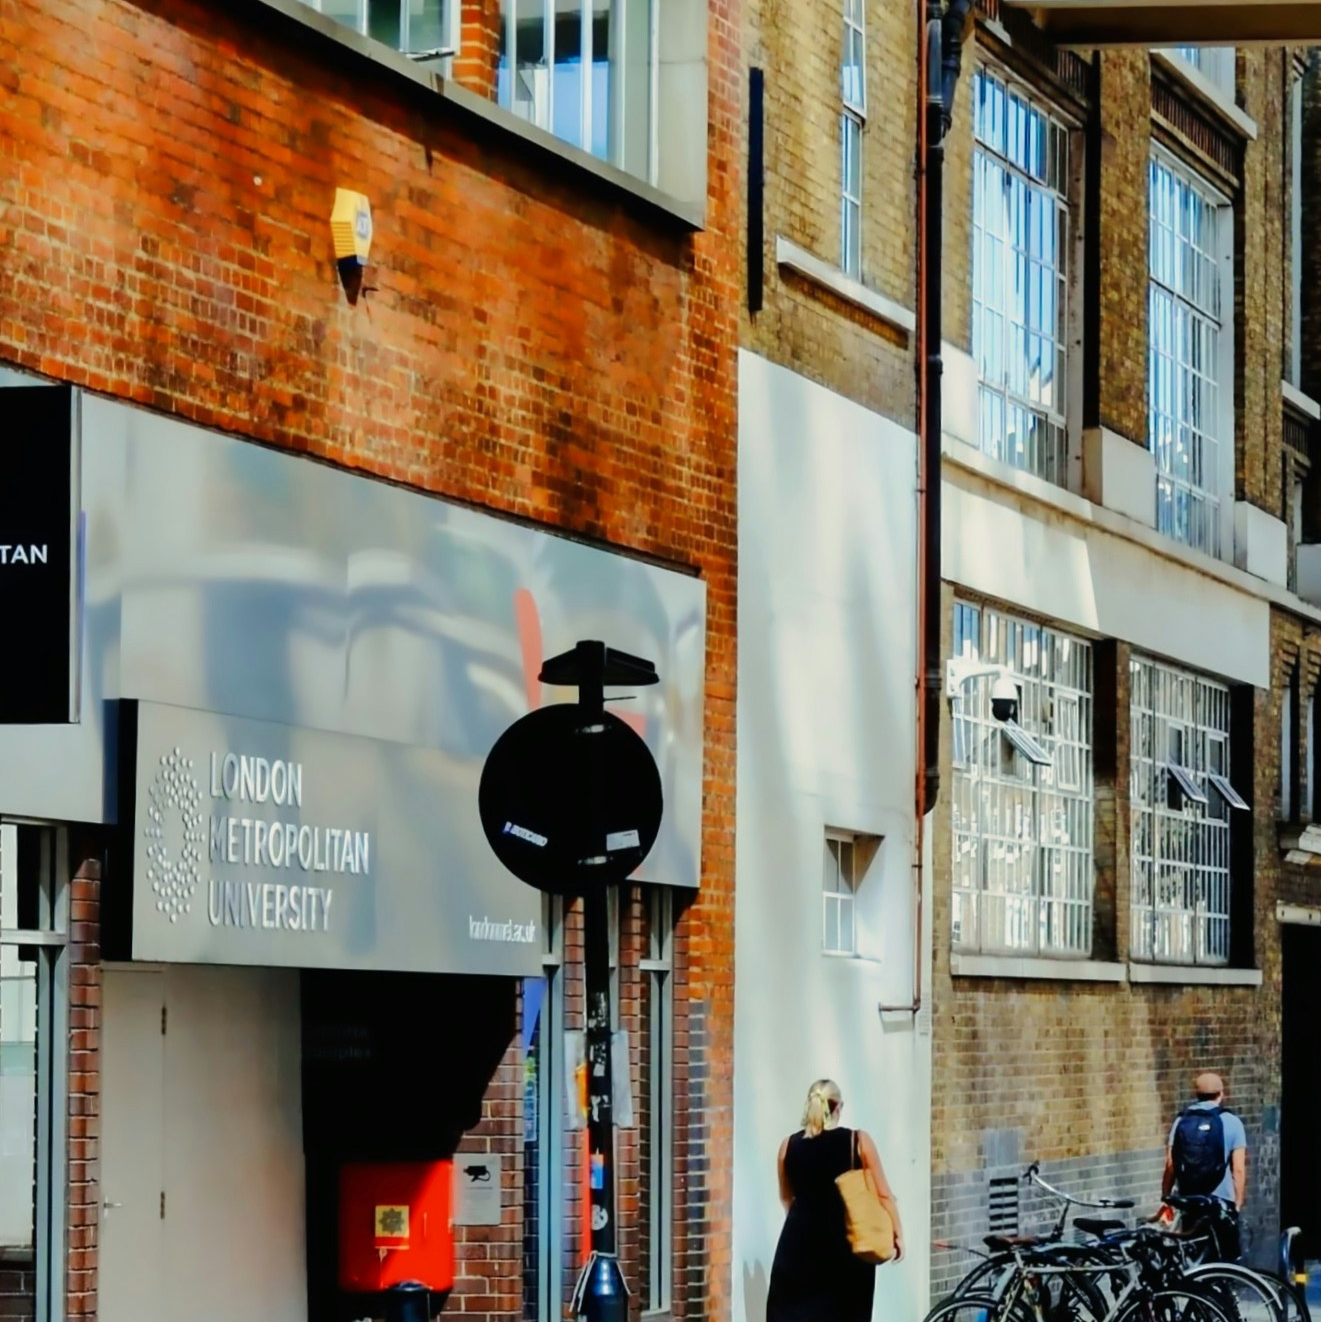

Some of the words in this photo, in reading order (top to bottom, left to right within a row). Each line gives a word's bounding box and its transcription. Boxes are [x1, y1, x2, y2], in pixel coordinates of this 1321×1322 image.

[209, 750, 303, 807] LONDON
[208, 815, 370, 875] METROPOLITAN
[207, 879, 333, 931] UNIVERSITY
